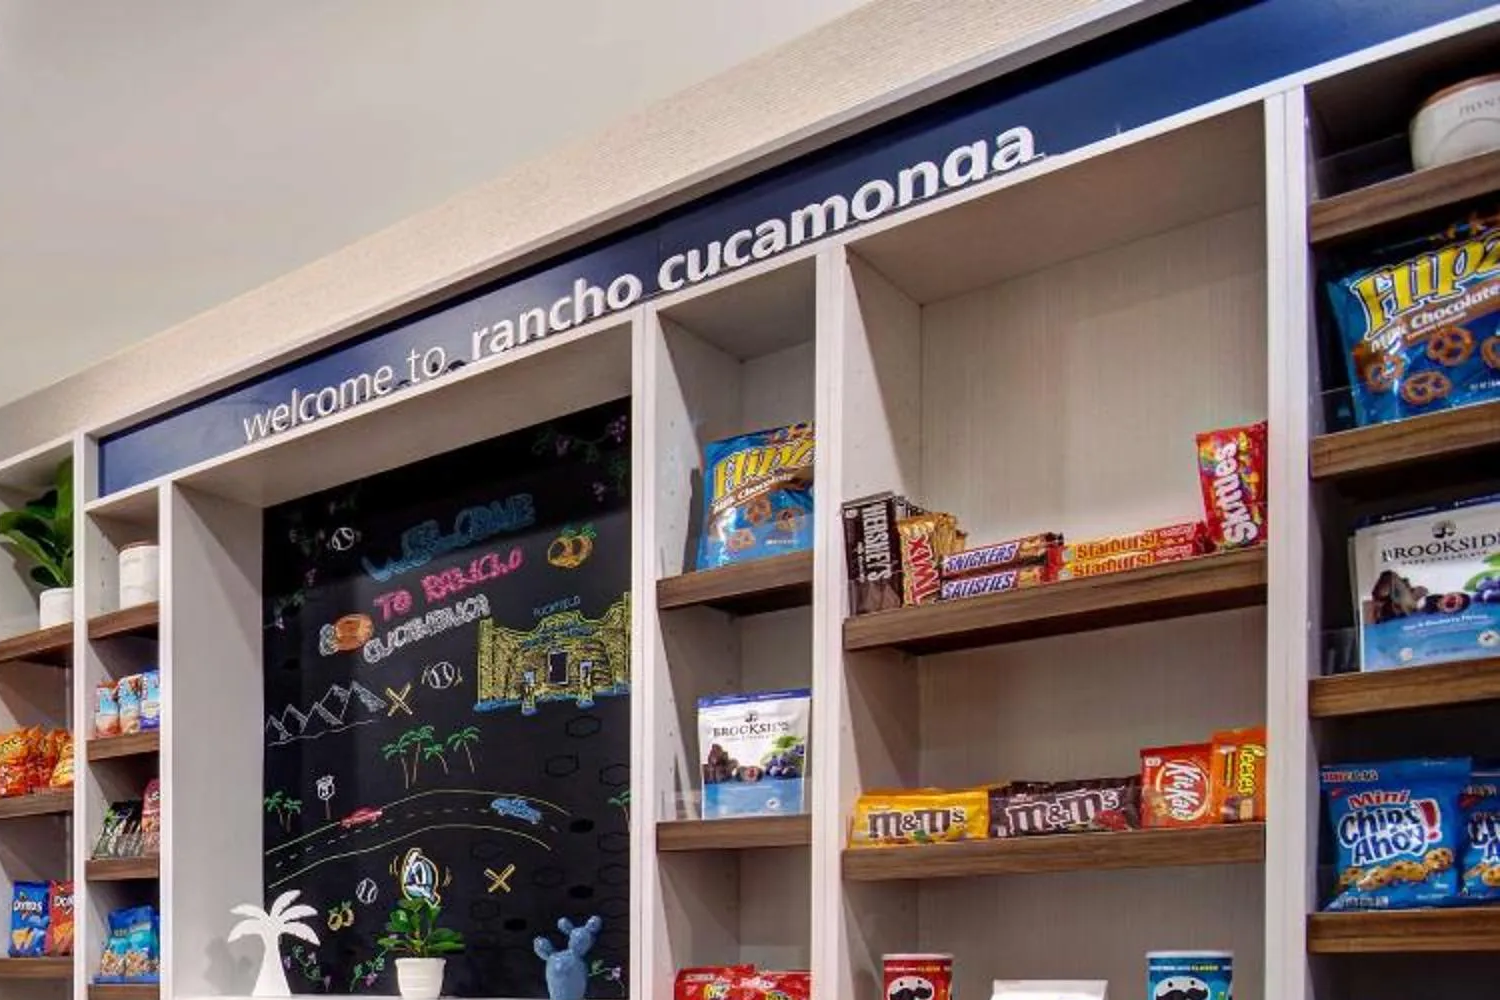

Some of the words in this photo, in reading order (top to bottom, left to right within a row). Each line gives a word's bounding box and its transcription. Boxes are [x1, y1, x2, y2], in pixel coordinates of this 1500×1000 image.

[242, 363, 393, 442] welcome
[406, 342, 446, 384] to
[471, 268, 643, 360] rancho
[658, 126, 1037, 291] cucamonga
[943, 543, 1018, 573] SNICKERS
